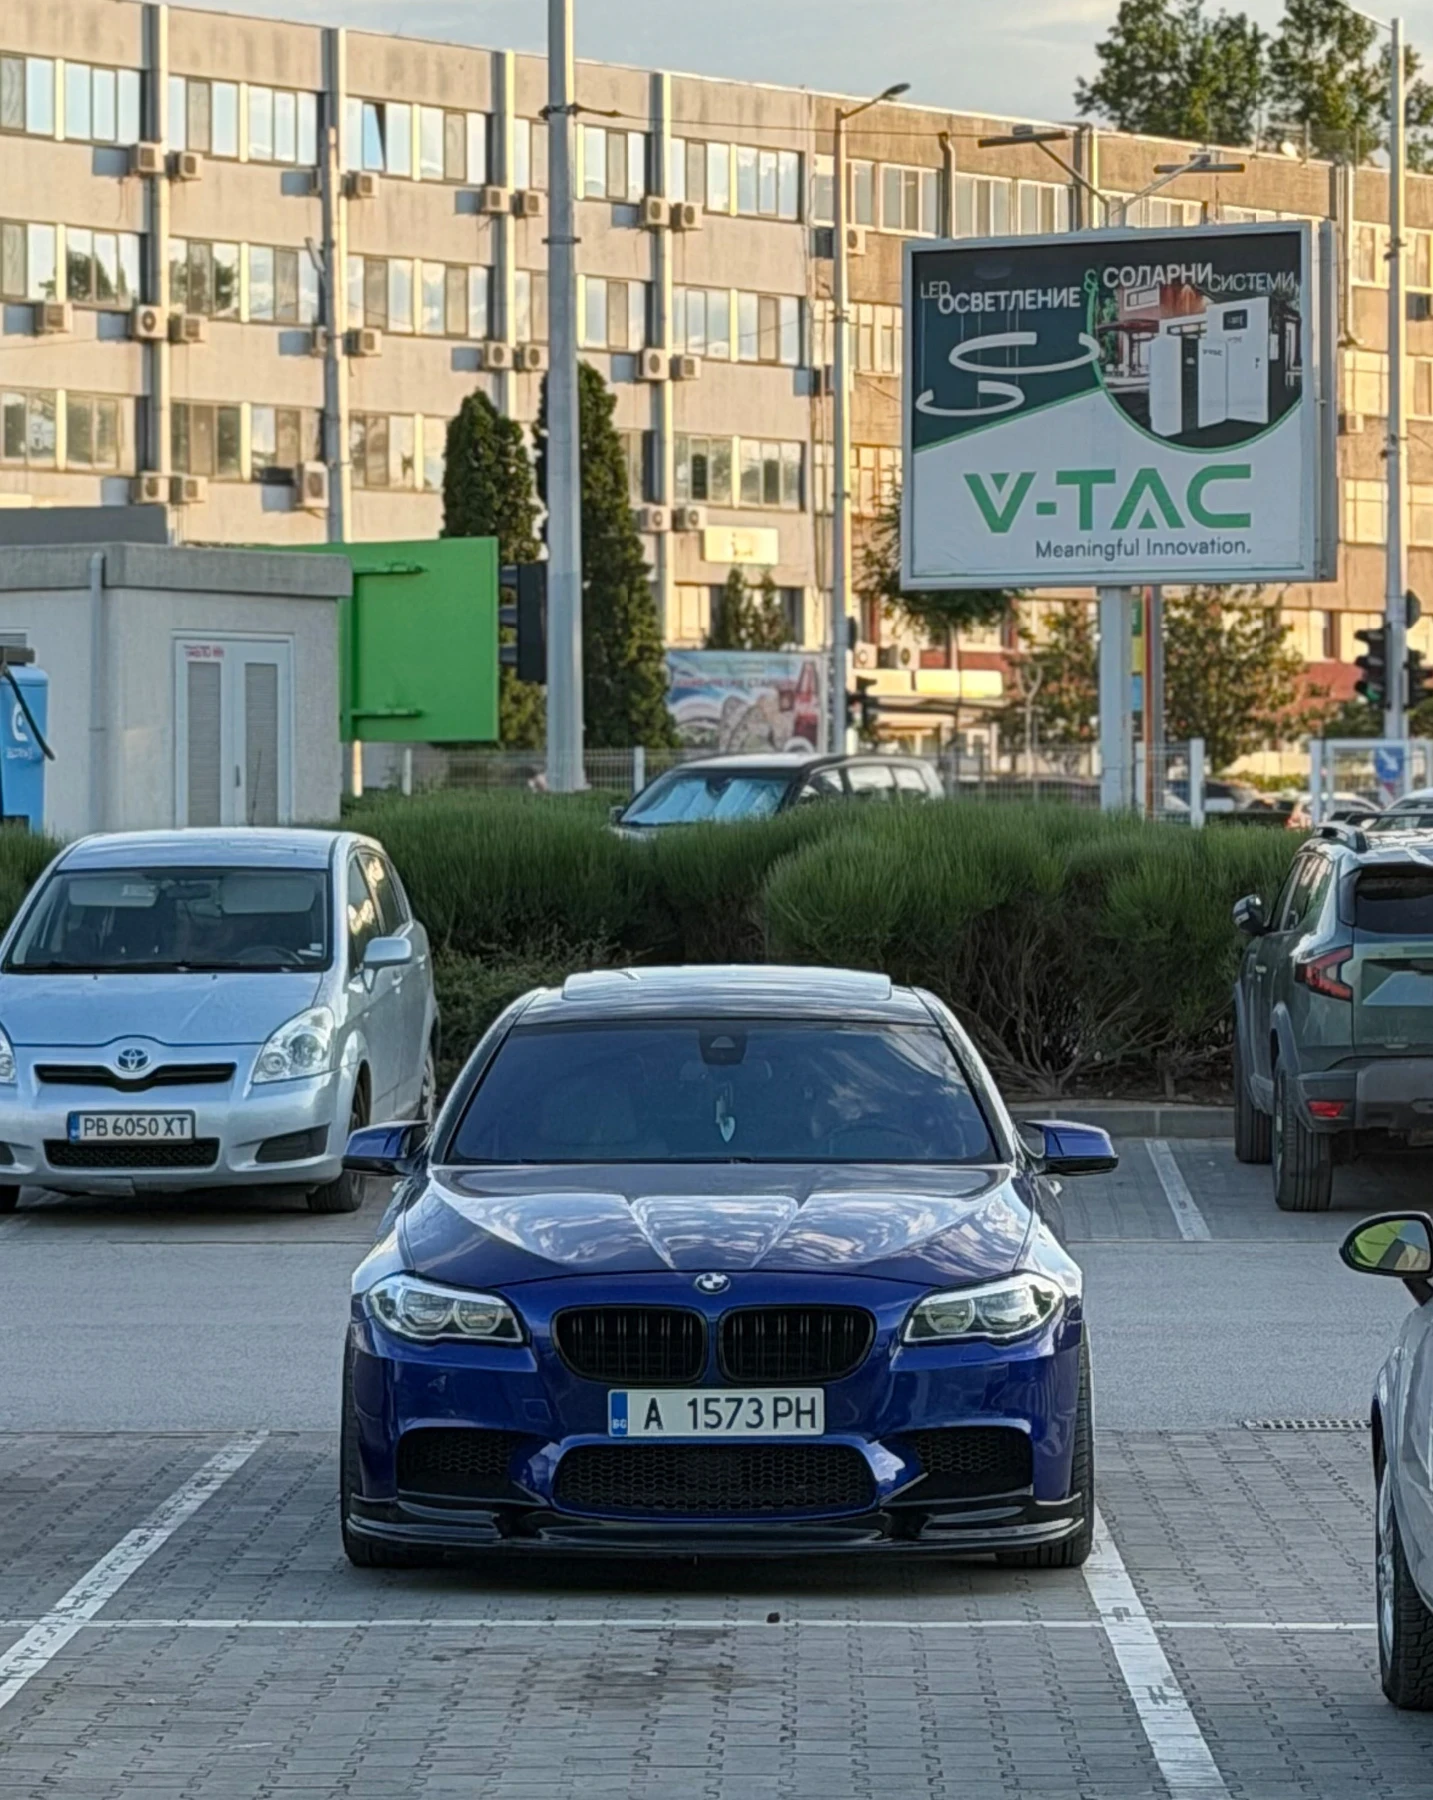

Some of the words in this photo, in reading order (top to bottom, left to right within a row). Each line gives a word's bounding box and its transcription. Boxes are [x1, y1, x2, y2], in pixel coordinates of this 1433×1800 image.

[920, 281, 950, 299] LED
[938, 287, 1081, 314] ОСВЕТЛЕНИЕ
[1103, 262, 1213, 288] СОЛАРНИ
[1208, 271, 1295, 293] СИСТЕМИ
[963, 464, 1252, 534] V-TAC
[1035, 538, 1139, 562] Meaningful
[1146, 537, 1252, 557] Innovation.
[83, 1117, 108, 1136] PB
[112, 1117, 159, 1136] 6050
[163, 1117, 188, 1136] XT
[643, 1397, 664, 1431] A
[687, 1397, 764, 1430] 1573
[773, 1396, 816, 1429] PH
